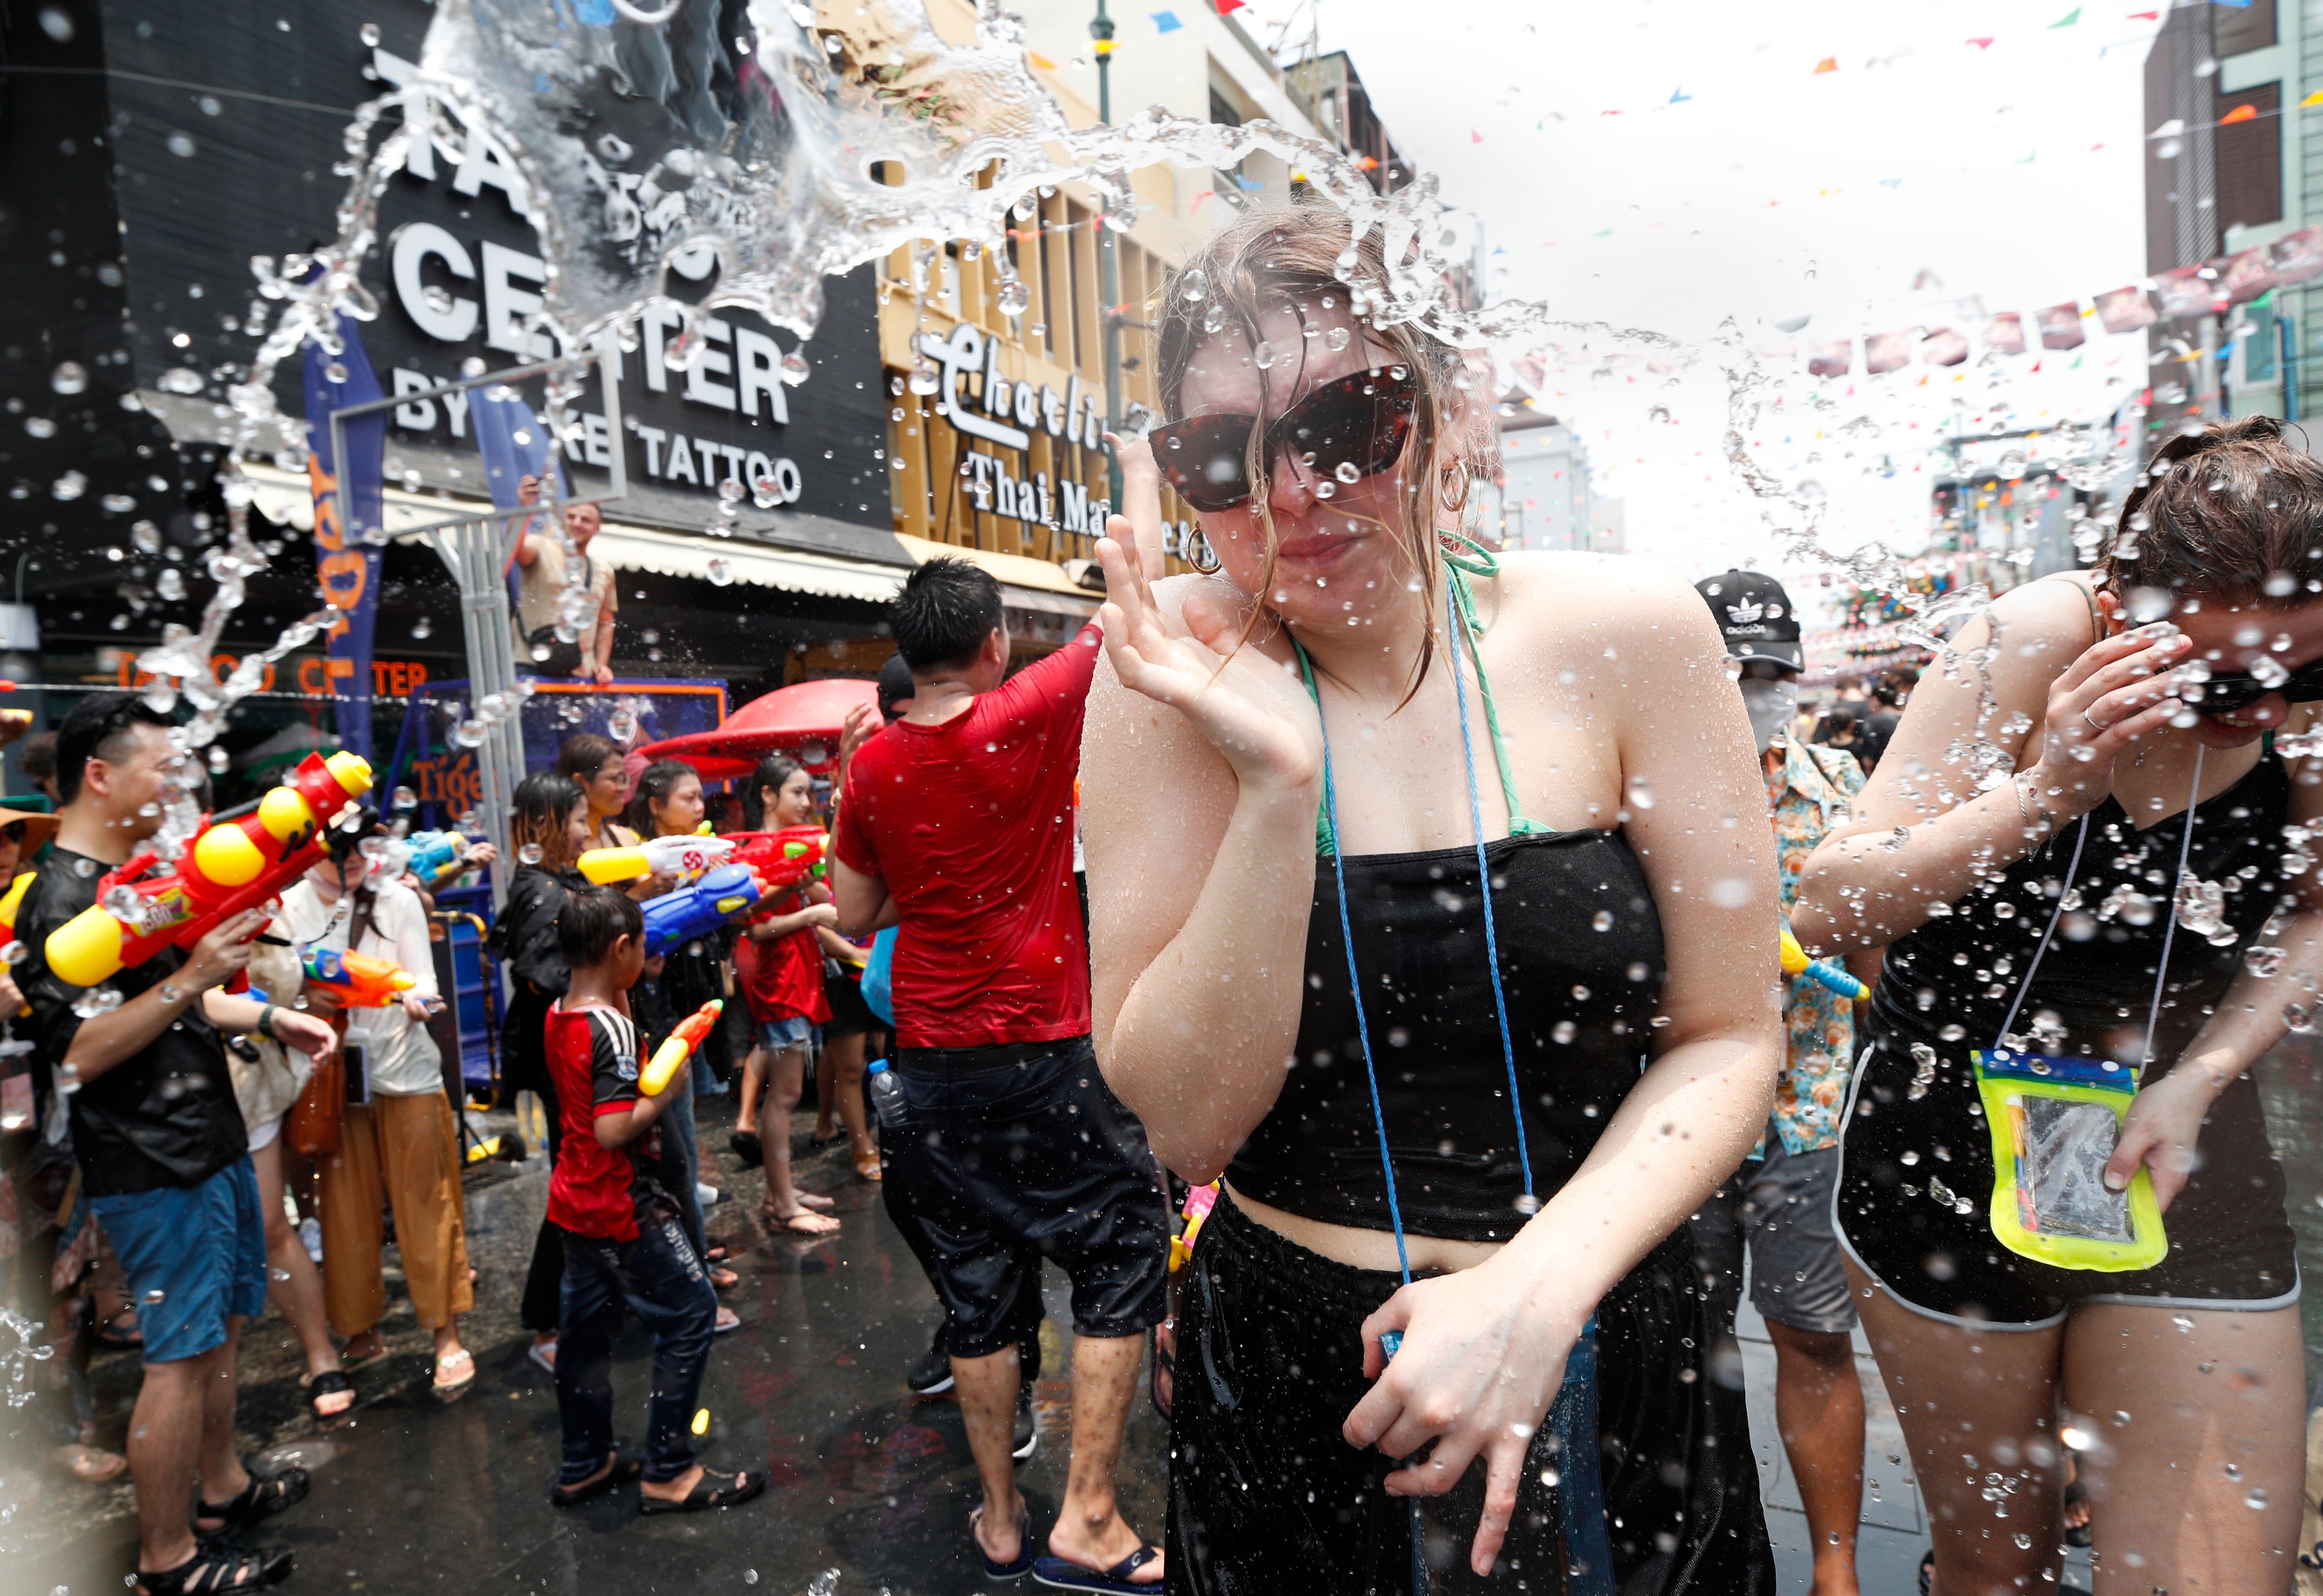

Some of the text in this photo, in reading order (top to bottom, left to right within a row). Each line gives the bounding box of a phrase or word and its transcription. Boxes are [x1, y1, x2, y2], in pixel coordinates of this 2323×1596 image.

[392, 222, 789, 425] CETER
[393, 367, 467, 438] BY
[637, 425, 802, 503] TATTOO
[967, 450, 1050, 526] Thai
[1726, 623, 1766, 634] adidas
[298, 658, 427, 697] CTER
[411, 752, 505, 821] Tige
